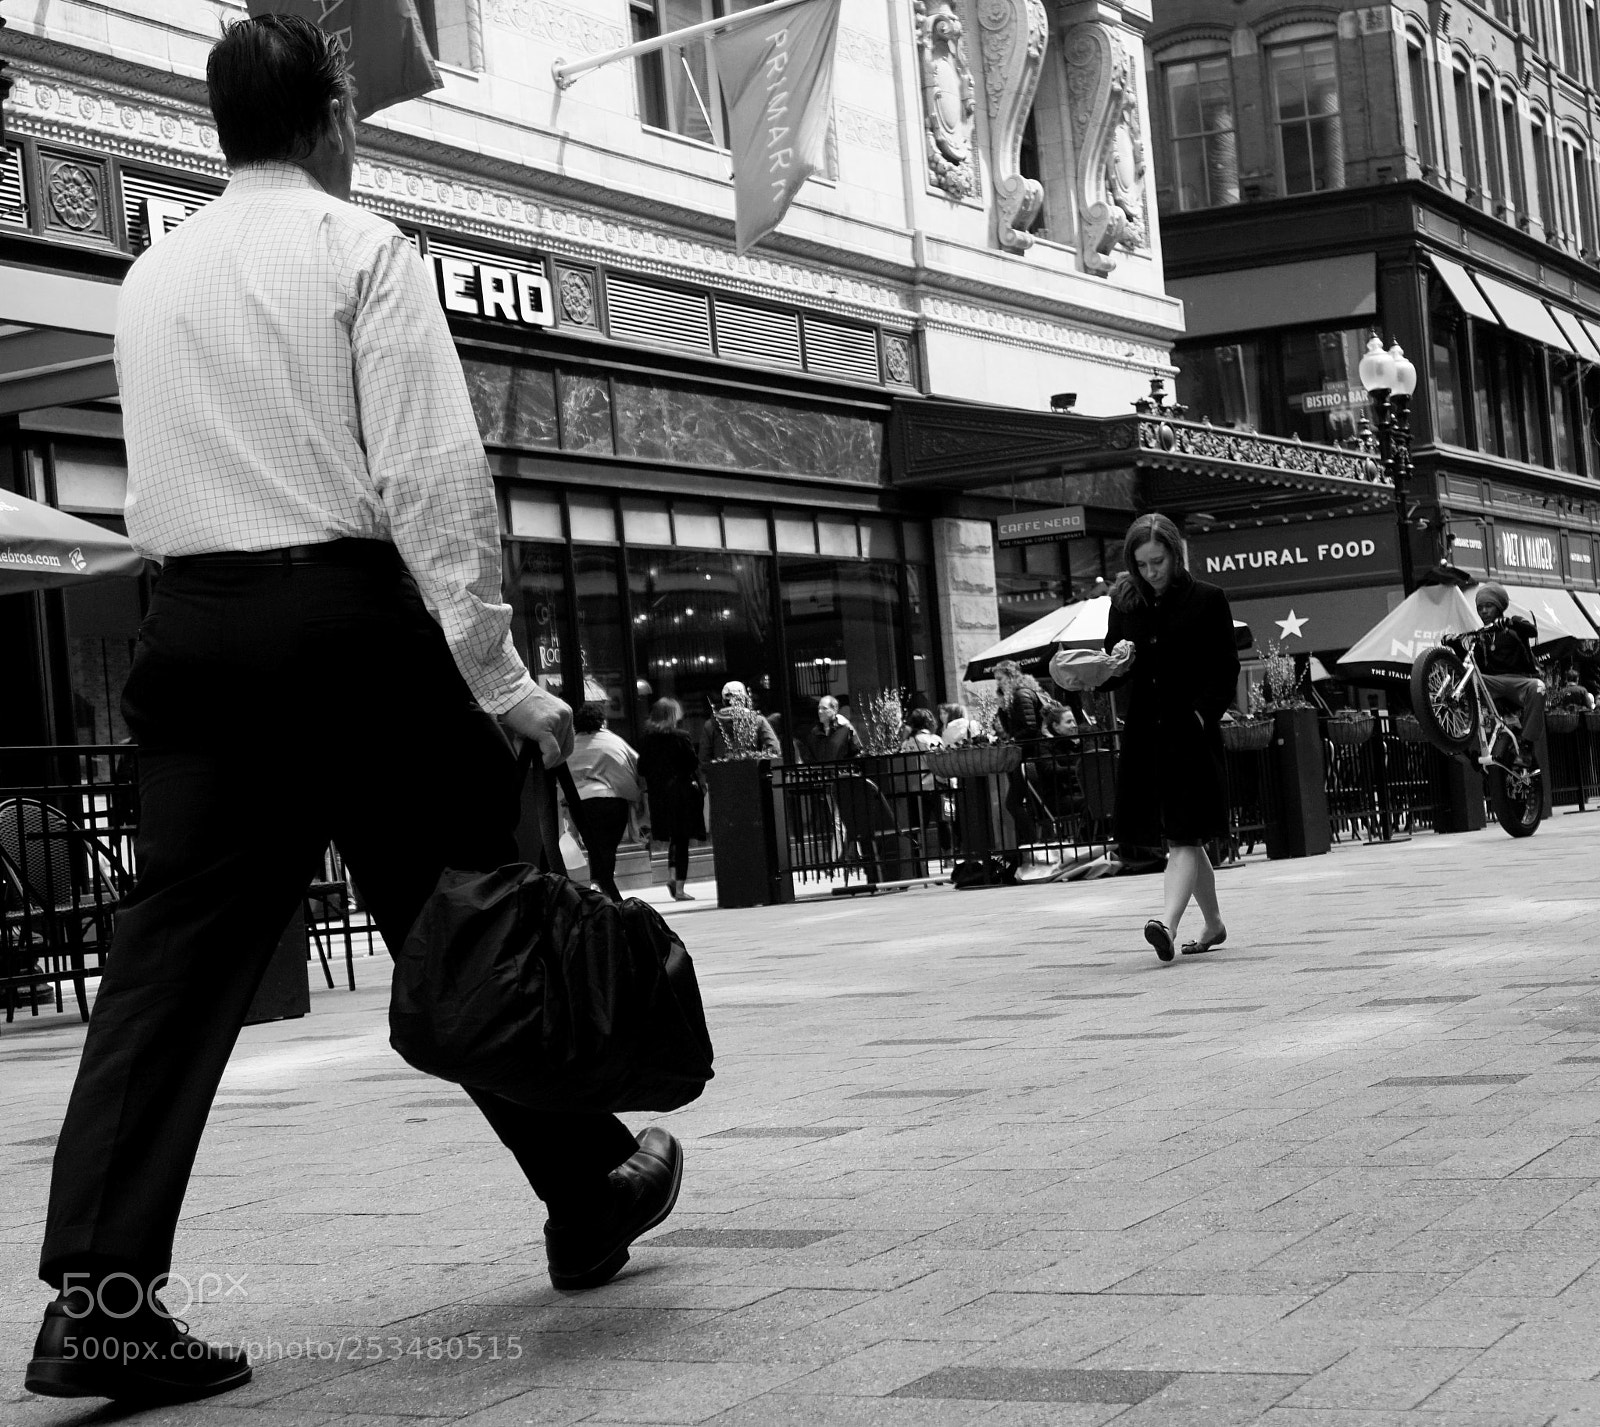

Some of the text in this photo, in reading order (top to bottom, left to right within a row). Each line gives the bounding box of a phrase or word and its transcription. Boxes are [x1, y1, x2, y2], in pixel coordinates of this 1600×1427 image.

[1305, 393, 1341, 408] BISTRO
[1348, 389, 1369, 403] BAR
[1044, 516, 1080, 528] NERO
[0, 547, 61, 567] ebros.com
[1206, 539, 1376, 573] NATURAL FOOD
[1371, 668, 1412, 680] THE ITALIA
